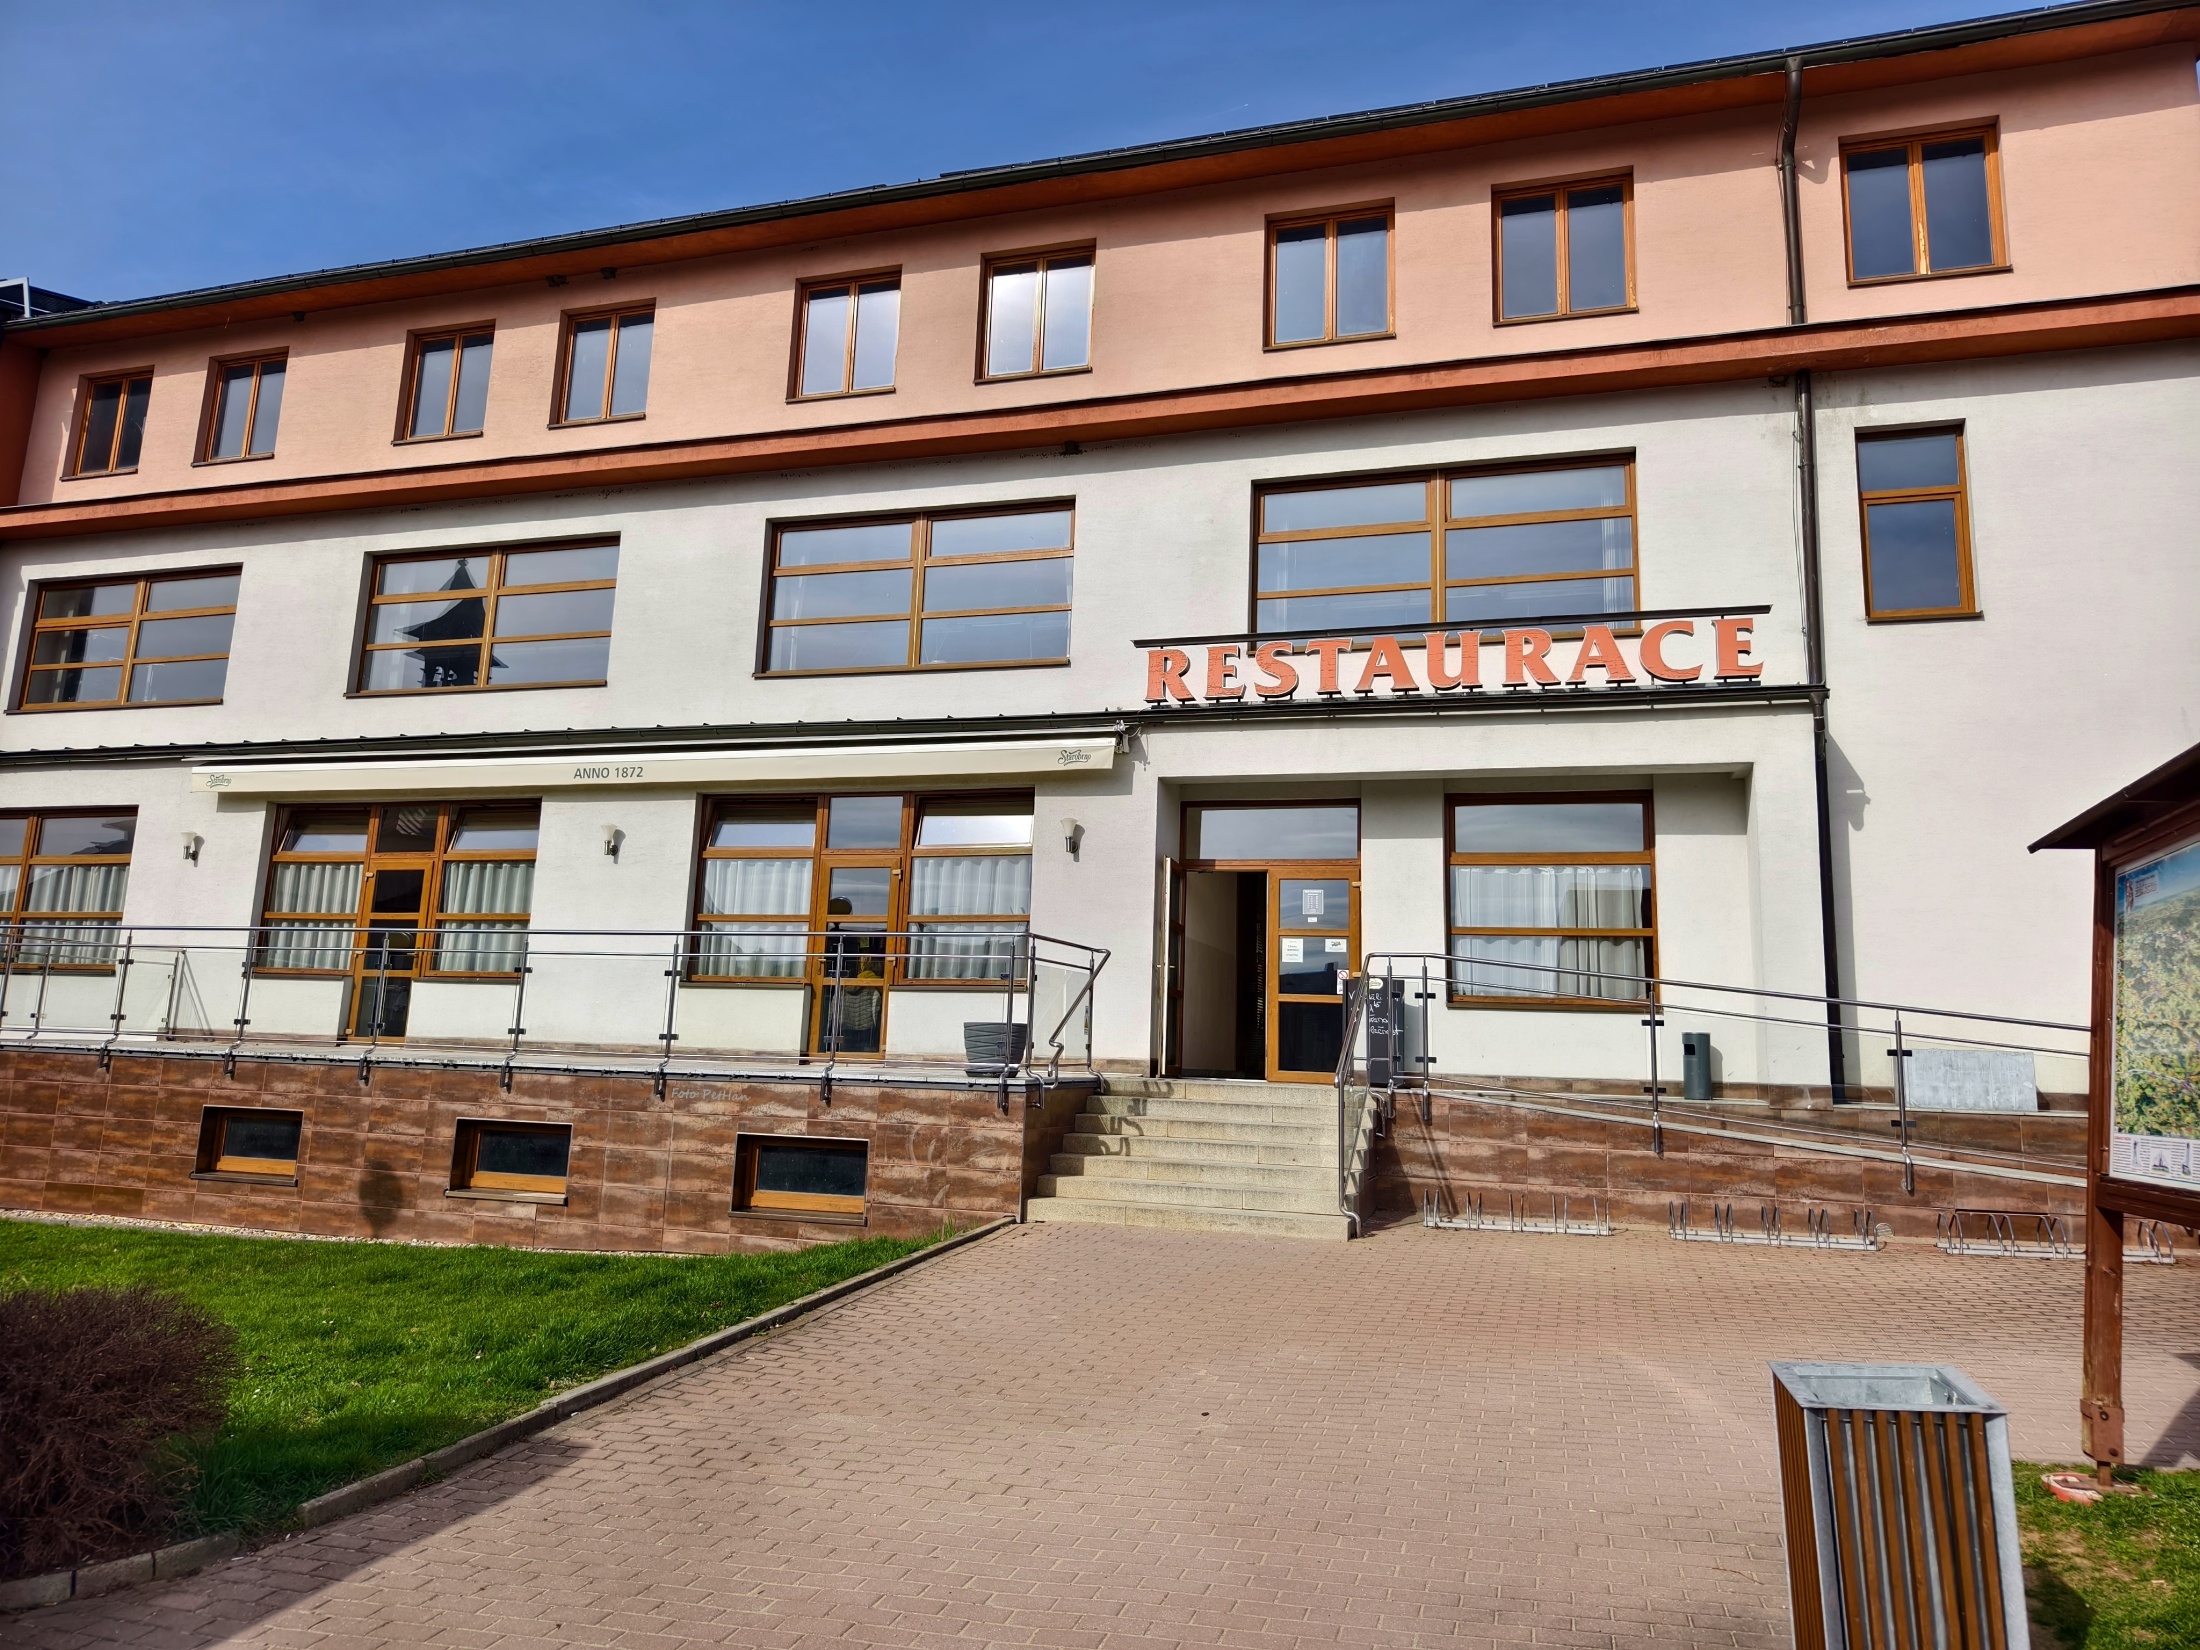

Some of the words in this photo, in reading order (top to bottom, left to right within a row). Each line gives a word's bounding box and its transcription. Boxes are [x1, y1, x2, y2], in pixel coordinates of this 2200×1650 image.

[1144, 617, 1765, 703] RESTAURACE
[573, 767, 610, 779] ANNO
[614, 766, 644, 779] 1872
